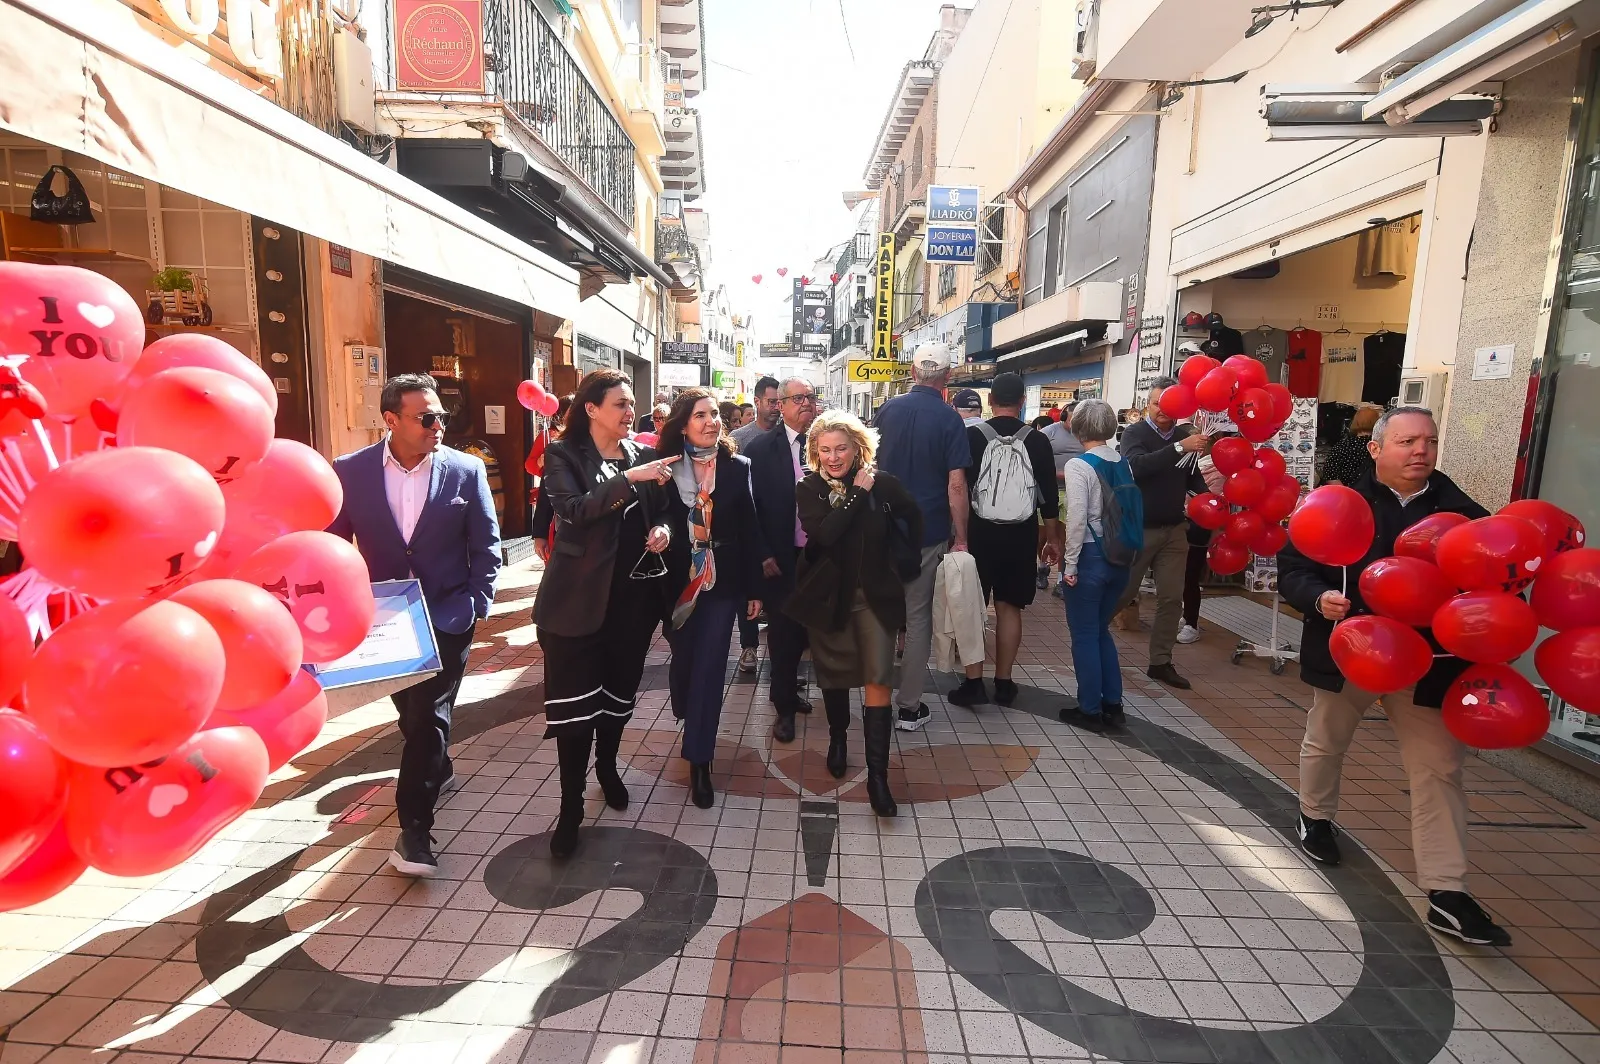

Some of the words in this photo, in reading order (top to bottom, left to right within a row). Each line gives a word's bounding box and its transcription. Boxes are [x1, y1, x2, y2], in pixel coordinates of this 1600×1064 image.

[412, 36, 464, 50] Réchaud
[929, 244, 954, 256] DON
[876, 234, 892, 359] PAPELERIA
[38, 296, 64, 324] I
[794, 281, 802, 350] STRASS
[28, 329, 125, 363] YOU
[665, 342, 705, 353] COSMOS
[1506, 562, 1519, 580] I
